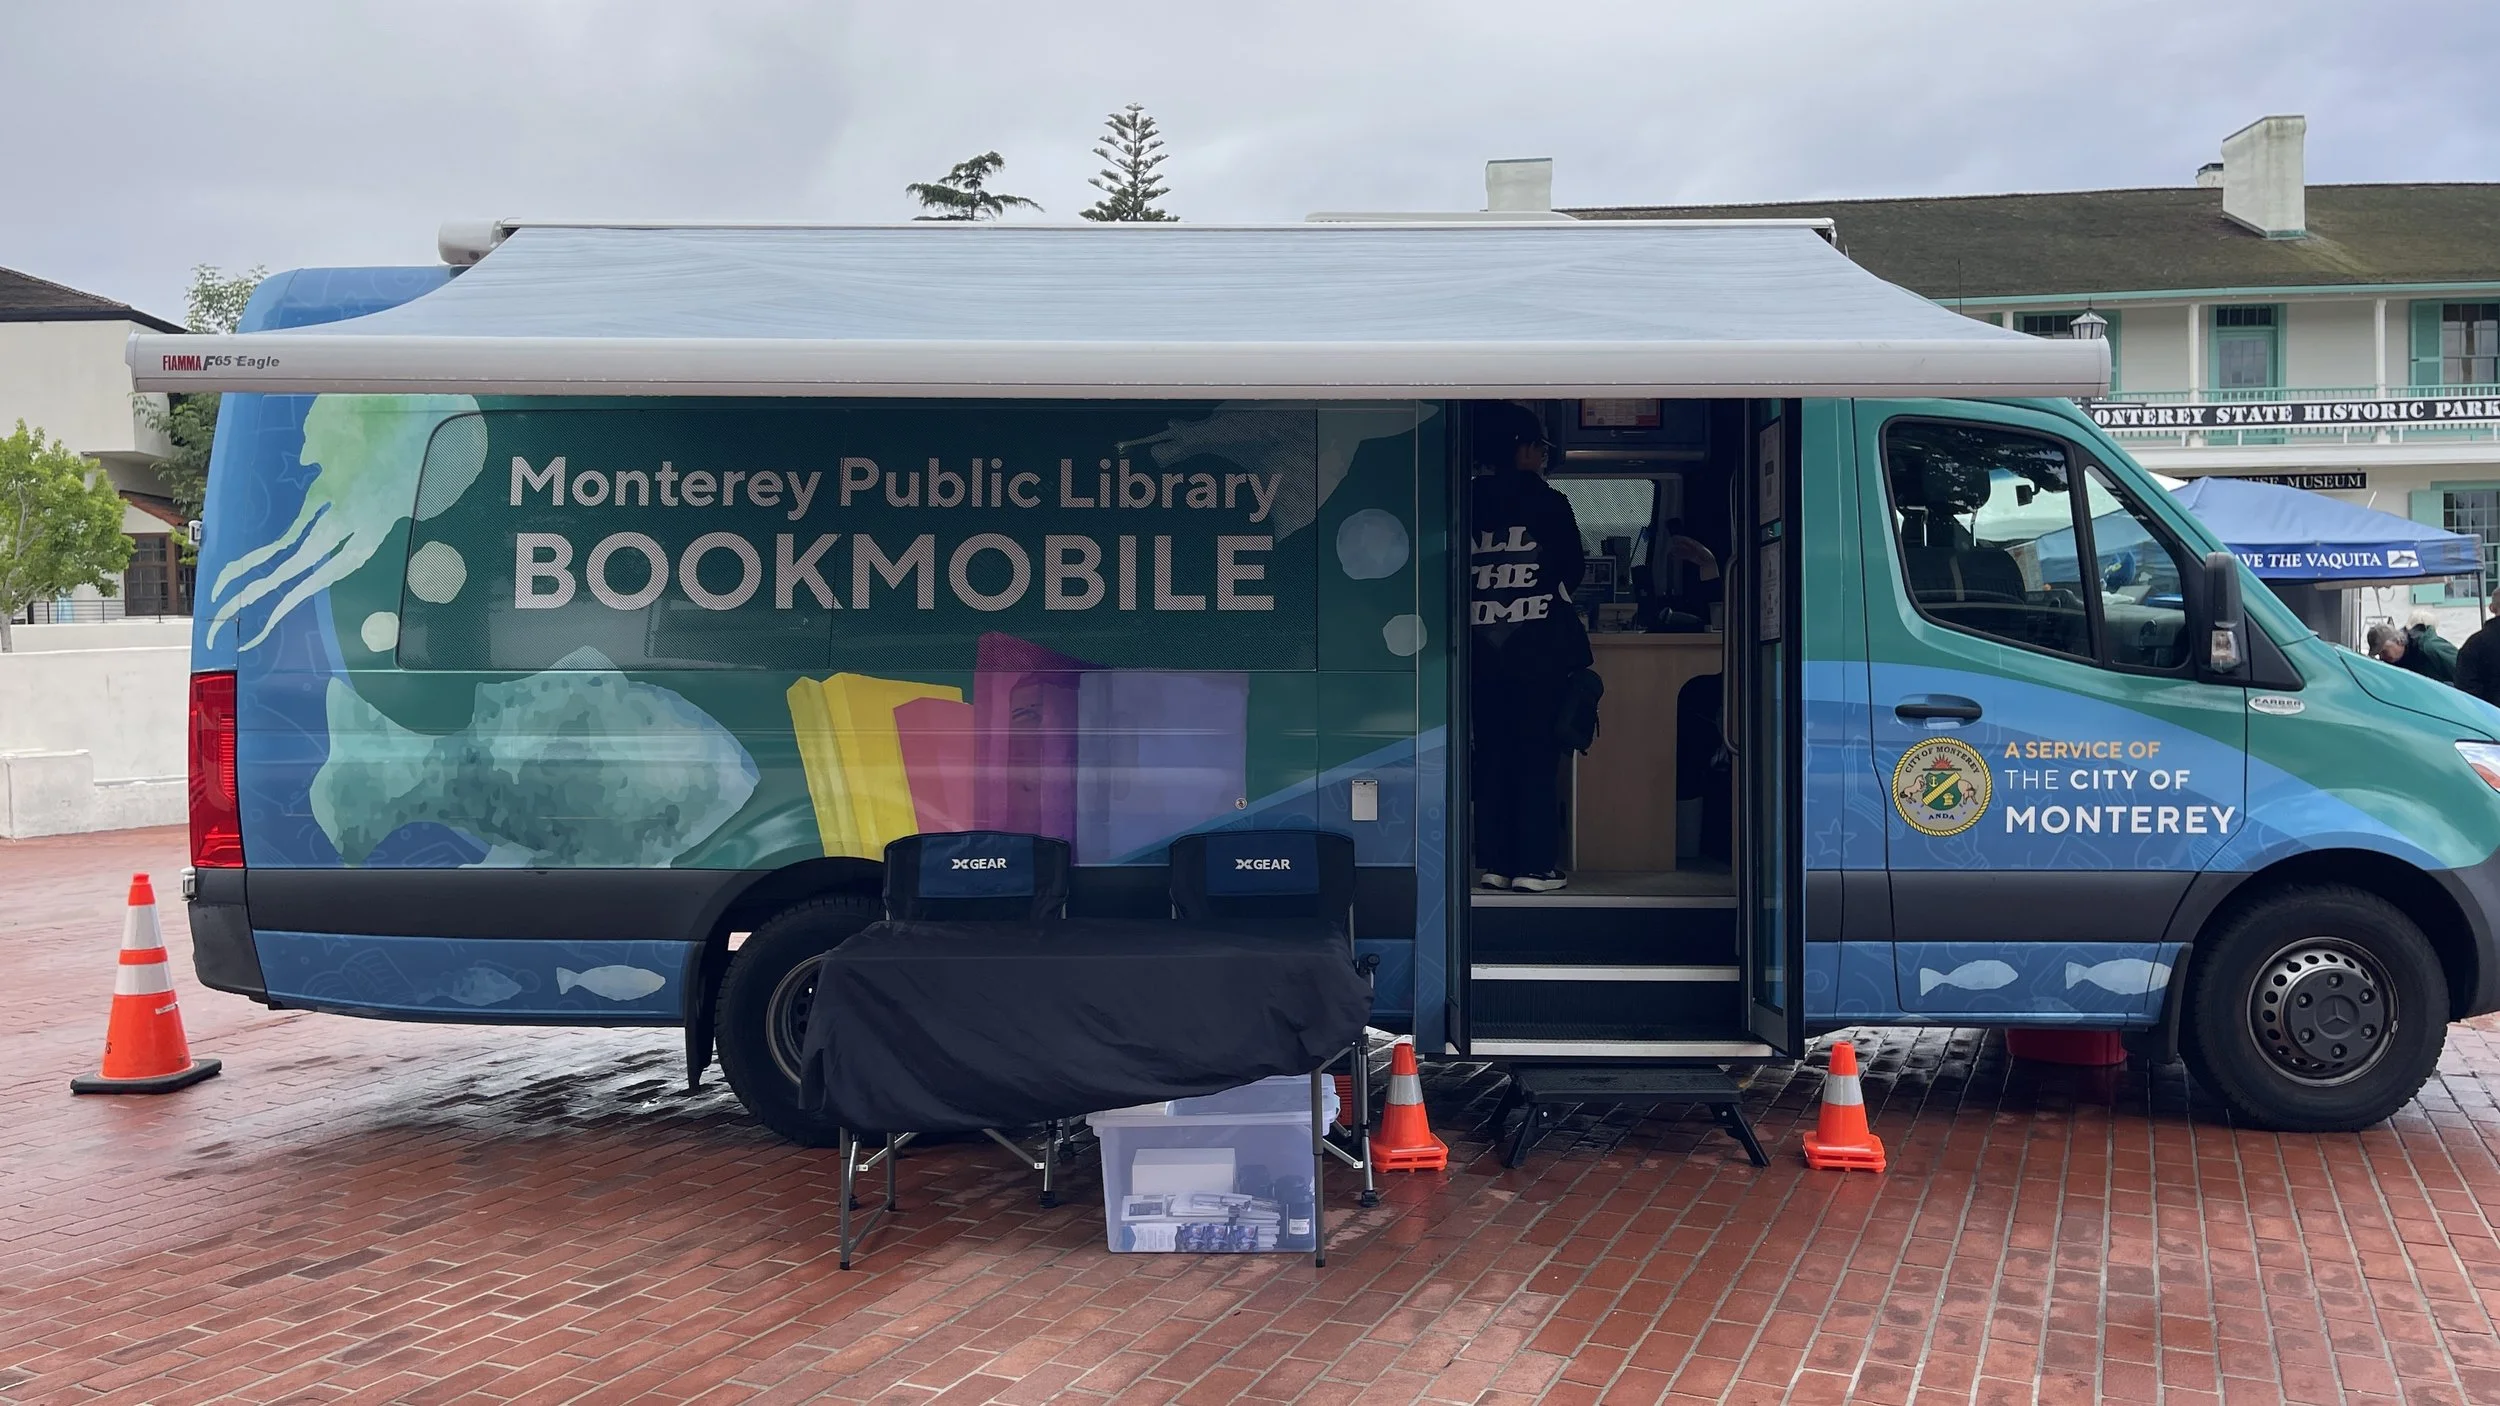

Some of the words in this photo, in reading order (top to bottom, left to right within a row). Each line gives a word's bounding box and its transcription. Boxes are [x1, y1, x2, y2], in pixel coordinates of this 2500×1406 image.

[163, 355, 201, 371] FIAMMA
[236, 356, 280, 370] Eagle
[2091, 407, 2206, 426] ONTEREY
[2216, 405, 2292, 424] STATE
[2304, 402, 2424, 421] HISTORIC
[2435, 400, 2500, 418] PARK
[510, 456, 822, 521] Monterey
[840, 457, 1042, 508] Public
[1060, 458, 1284, 524] Library
[2287, 475, 2362, 488] MUSEUM
[515, 531, 1275, 612] BOOKMOBILE
[2236, 553, 2264, 568] VE
[2268, 553, 2302, 568] THE
[2306, 552, 2382, 569] VAQUITA
[1471, 593, 1553, 625] IME
[1905, 754, 1921, 774] CITY
[1921, 747, 1934, 757] OF
[1936, 746, 1980, 774] MONTEREY
[2004, 741, 2020, 758] A
[2025, 741, 2122, 758] SERVICE
[2131, 741, 2161, 758] OF
[2005, 769, 2059, 789] THE
[2070, 769, 2139, 789] CITY
[2149, 769, 2190, 789] OF
[2006, 806, 2236, 833] MONTEREY
